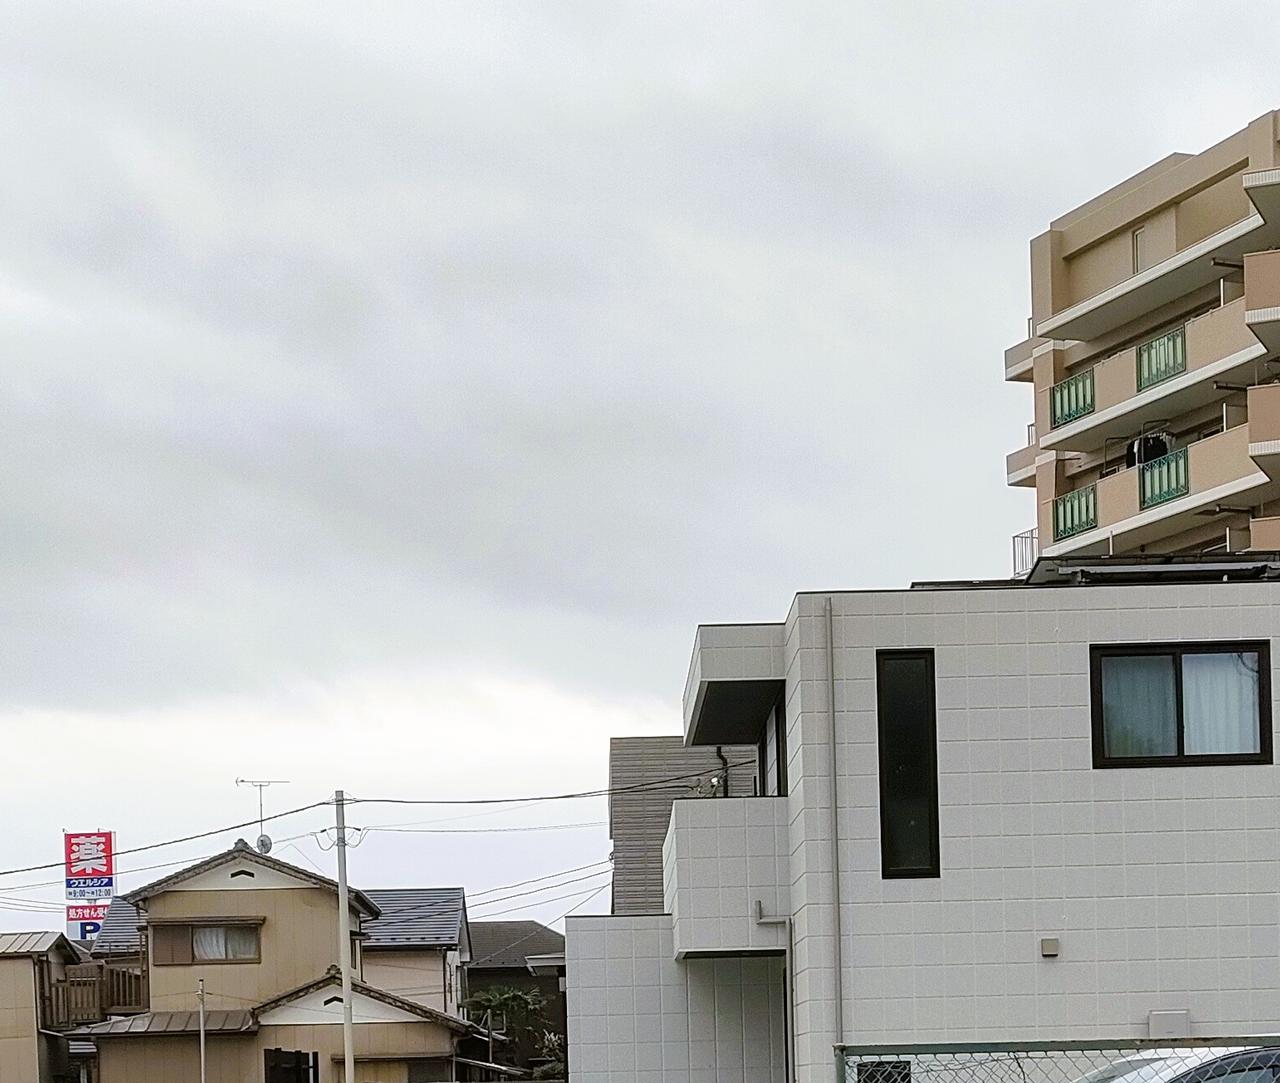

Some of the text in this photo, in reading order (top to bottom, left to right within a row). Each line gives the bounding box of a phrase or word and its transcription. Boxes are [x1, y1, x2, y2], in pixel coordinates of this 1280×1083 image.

[70, 836, 107, 874] 薬
[69, 878, 109, 888] ウエルシア
